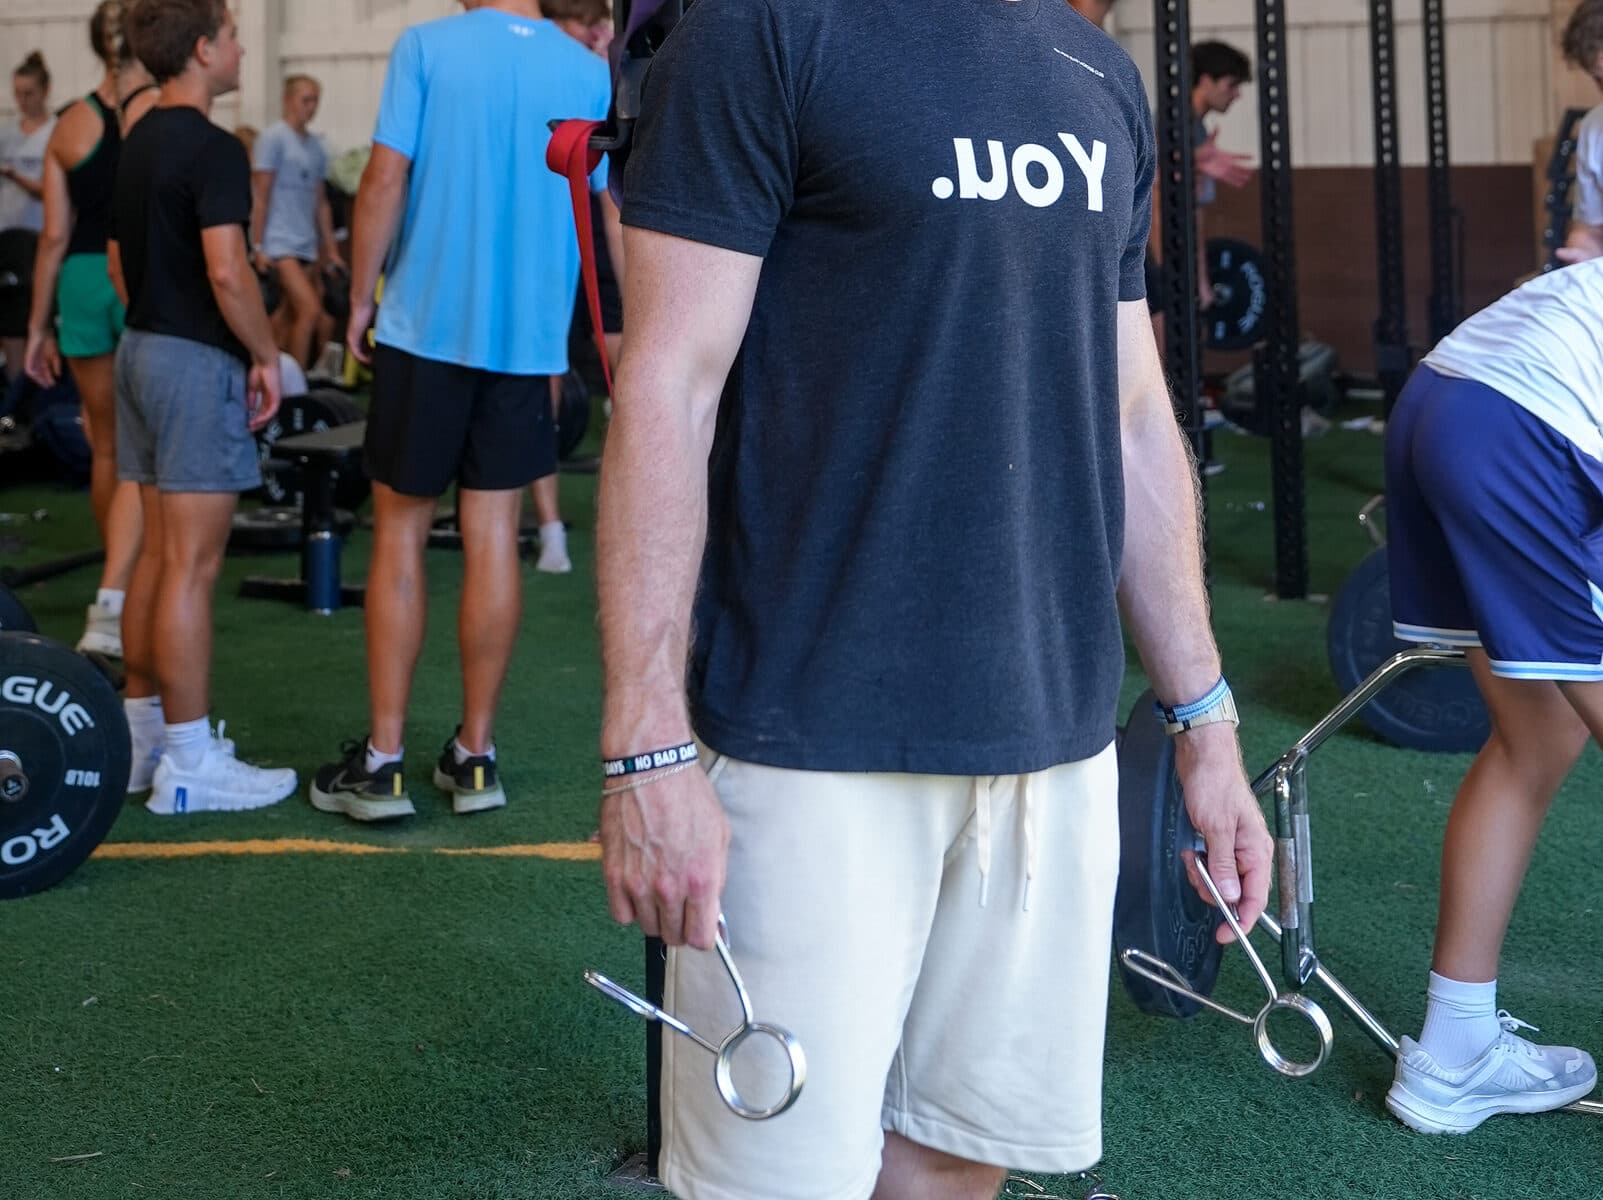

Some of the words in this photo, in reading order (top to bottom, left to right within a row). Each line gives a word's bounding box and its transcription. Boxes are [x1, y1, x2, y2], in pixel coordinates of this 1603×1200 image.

[0, 675, 96, 736] GUE
[634, 754, 652, 772] NO
[652, 748, 678, 768] BAD
